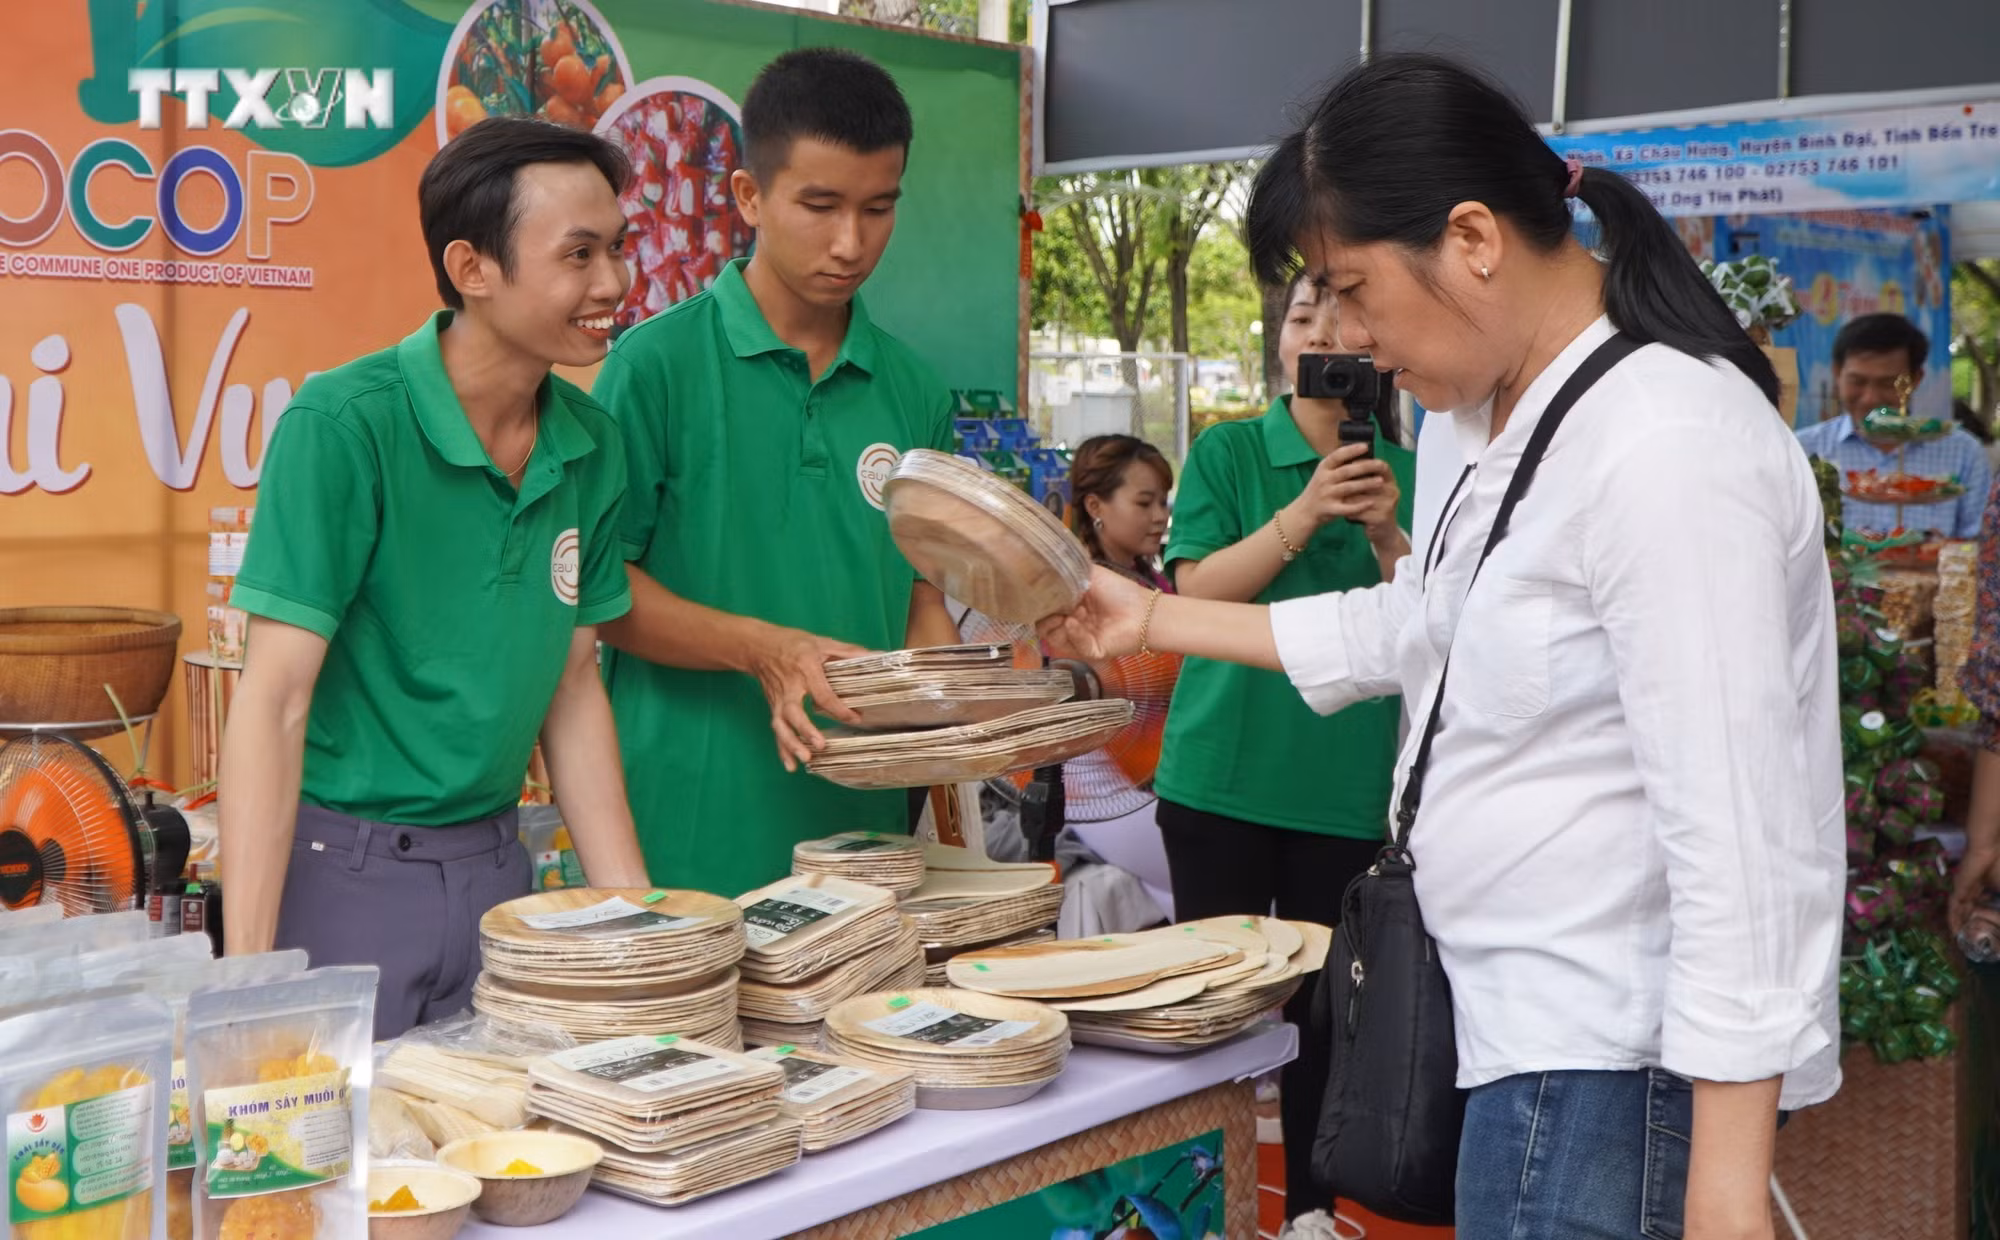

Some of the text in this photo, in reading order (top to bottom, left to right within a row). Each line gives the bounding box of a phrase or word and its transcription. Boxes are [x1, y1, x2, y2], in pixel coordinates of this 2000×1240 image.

[11, 256, 101, 275] COMMUNE
[106, 260, 140, 277] ONE
[145, 262, 220, 281] PRODUCT
[223, 265, 244, 281] OF
[247, 267, 312, 284] VIETNAM
[114, 303, 322, 492] Vu
[228, 1100, 270, 1117] KHÓM
